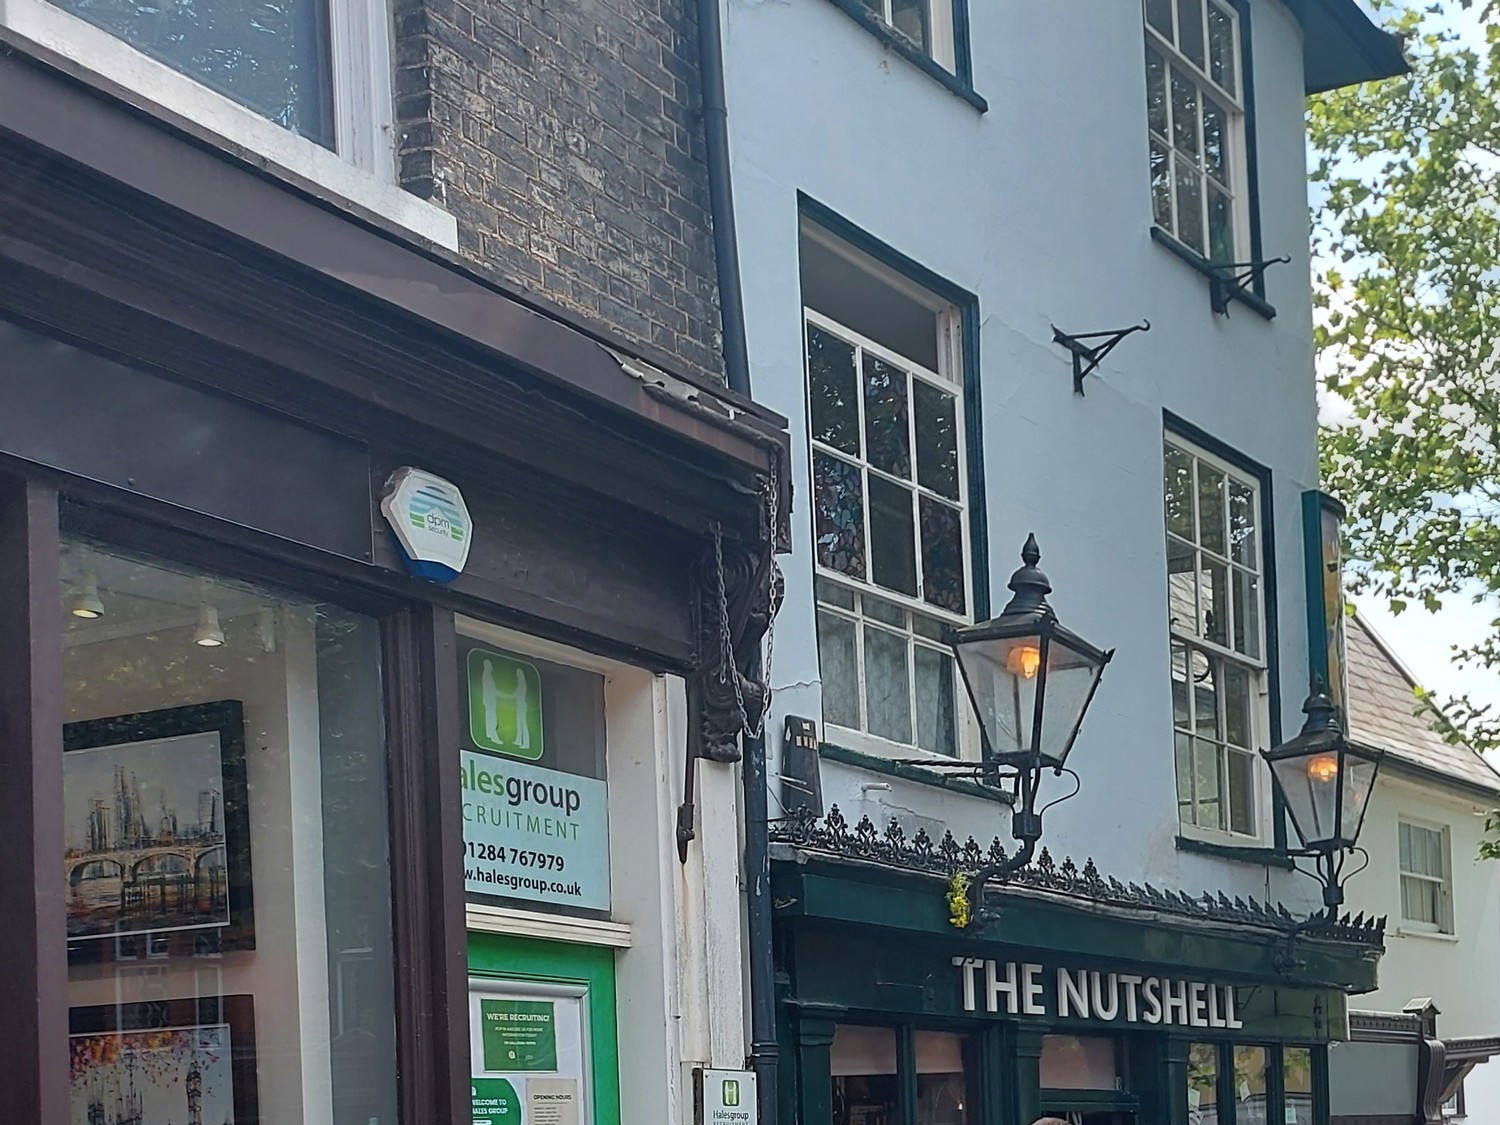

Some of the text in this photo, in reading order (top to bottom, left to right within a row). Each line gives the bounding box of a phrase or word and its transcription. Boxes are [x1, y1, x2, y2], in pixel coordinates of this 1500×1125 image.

[426, 513, 450, 530] dpm
[509, 847, 565, 872] 767979
[952, 956, 1243, 1029] THE NUTSHELL
[487, 1012, 550, 1022] WE'RE RECRUITING!
[488, 1107, 508, 1115] GROUP
[712, 1110, 749, 1121] Halesgroup
